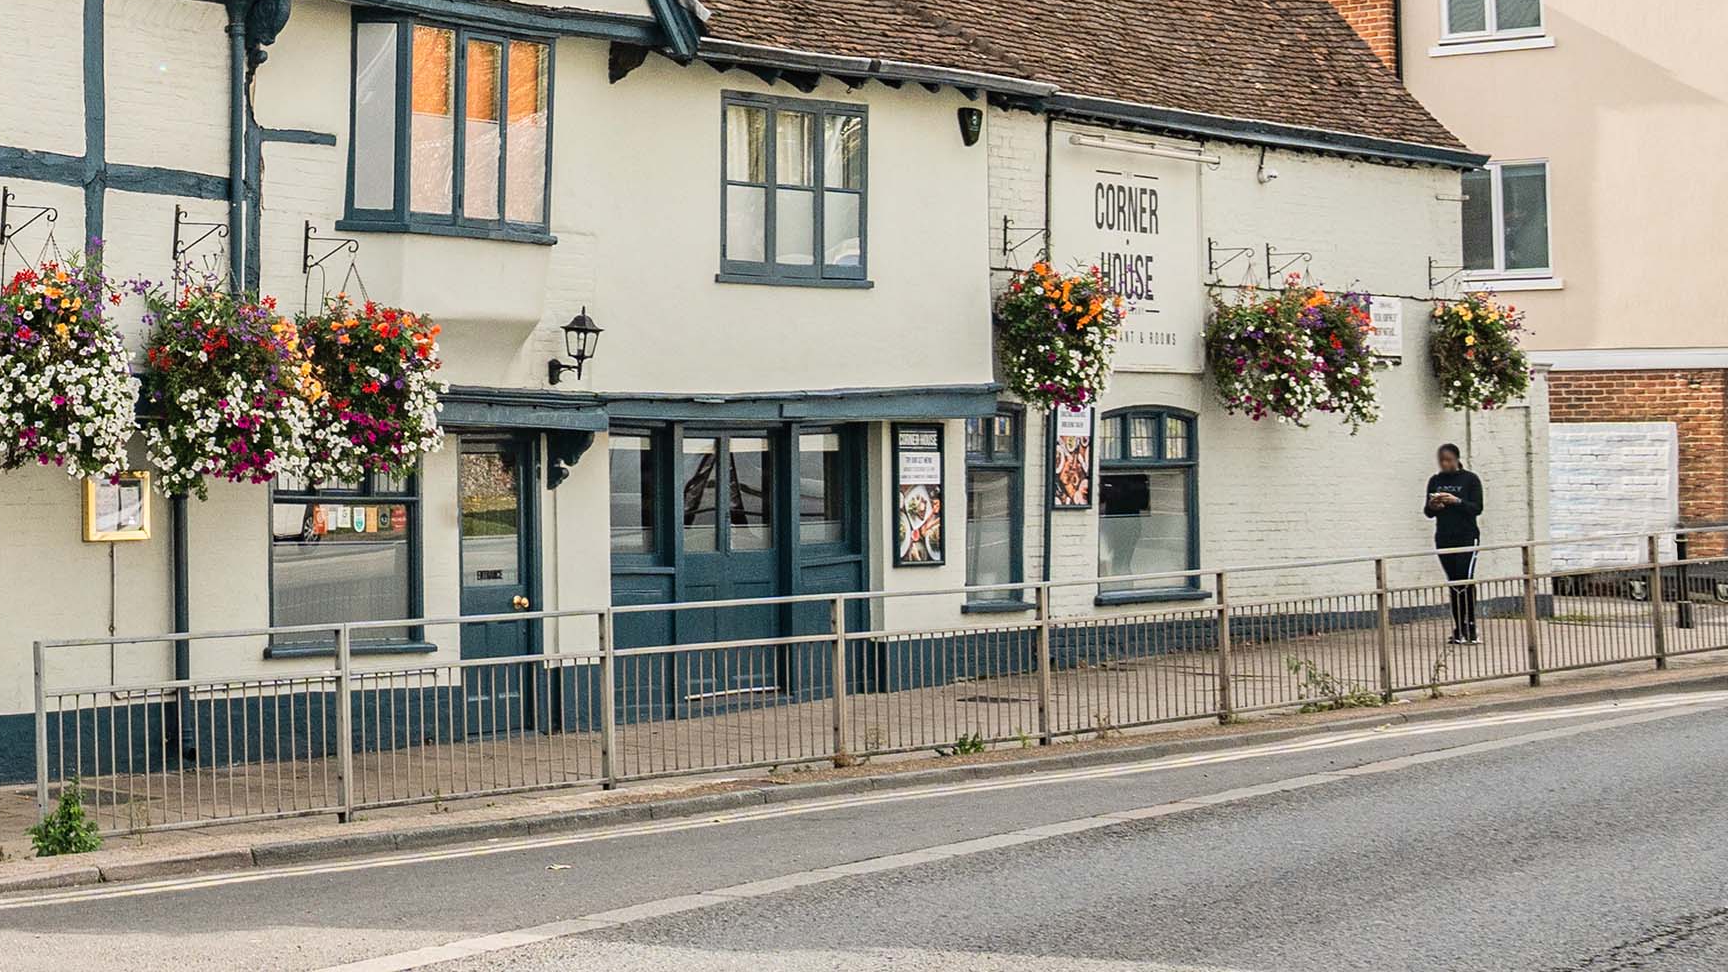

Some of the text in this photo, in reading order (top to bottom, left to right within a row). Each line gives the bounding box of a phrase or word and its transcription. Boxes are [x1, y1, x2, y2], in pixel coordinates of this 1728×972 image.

[1095, 182, 1159, 234] CORNER
[1101, 251, 1154, 301] HOUSE
[1150, 332, 1176, 346] ROOMS
